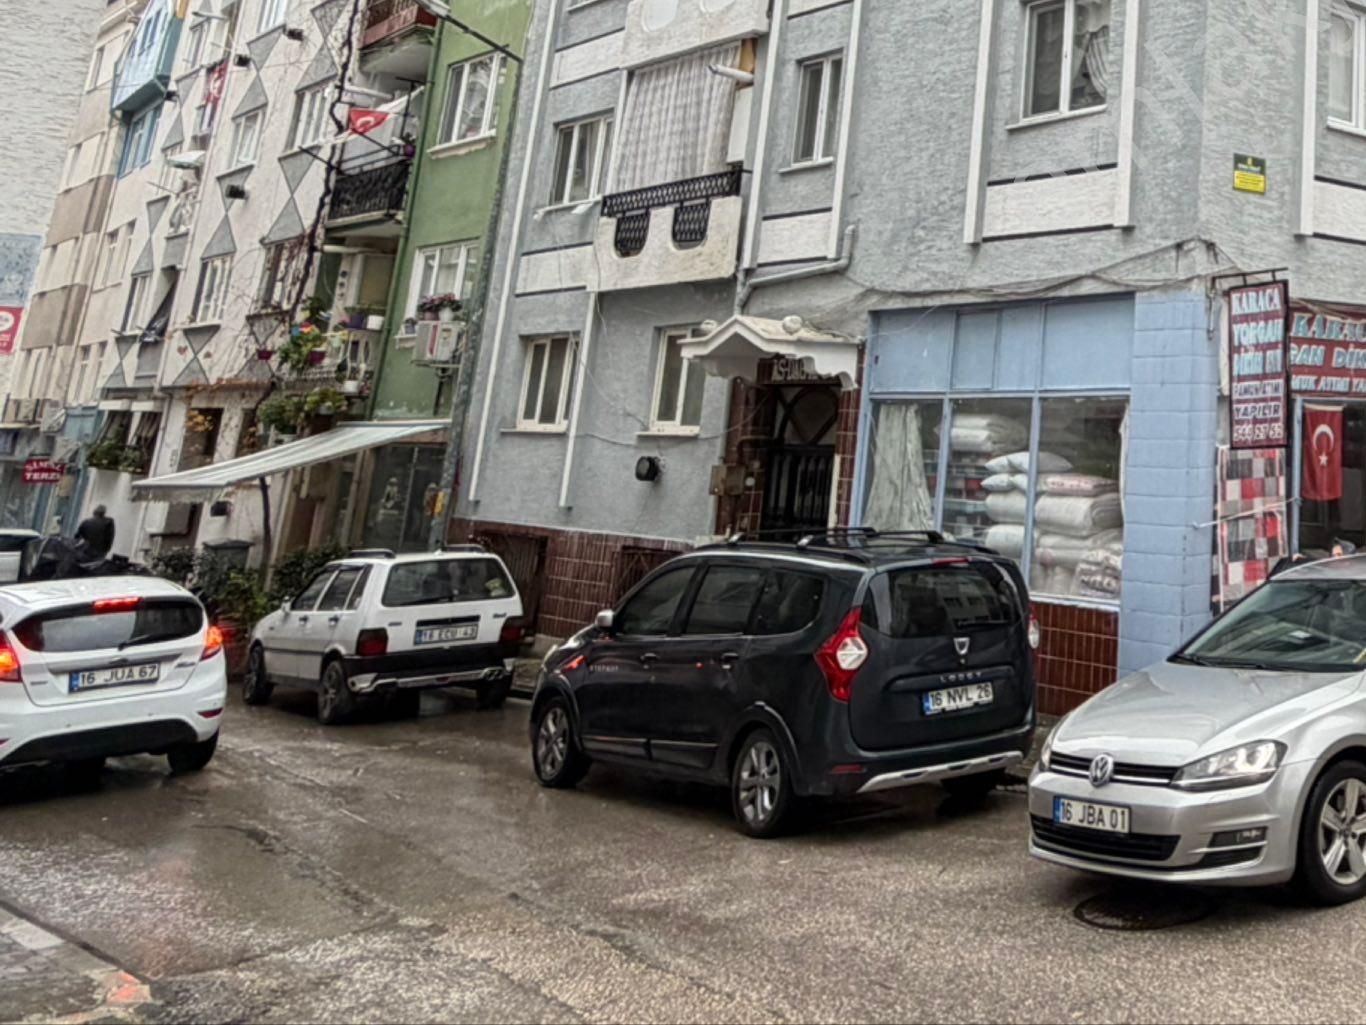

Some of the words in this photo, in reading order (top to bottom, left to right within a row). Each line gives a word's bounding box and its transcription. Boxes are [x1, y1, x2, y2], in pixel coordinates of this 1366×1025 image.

[1231, 288, 1281, 315] KARACA
[1232, 319, 1284, 347] YORGAN
[1233, 404, 1281, 419] YAPILIR
[81, 672, 96, 685] 16
[104, 668, 136, 683] JUA
[137, 665, 158, 679] 67
[929, 691, 943, 708] 16
[946, 686, 974, 705] NVL
[1061, 800, 1073, 822] 16
[1078, 804, 1106, 827] JBA
[1109, 808, 1126, 830] 01
